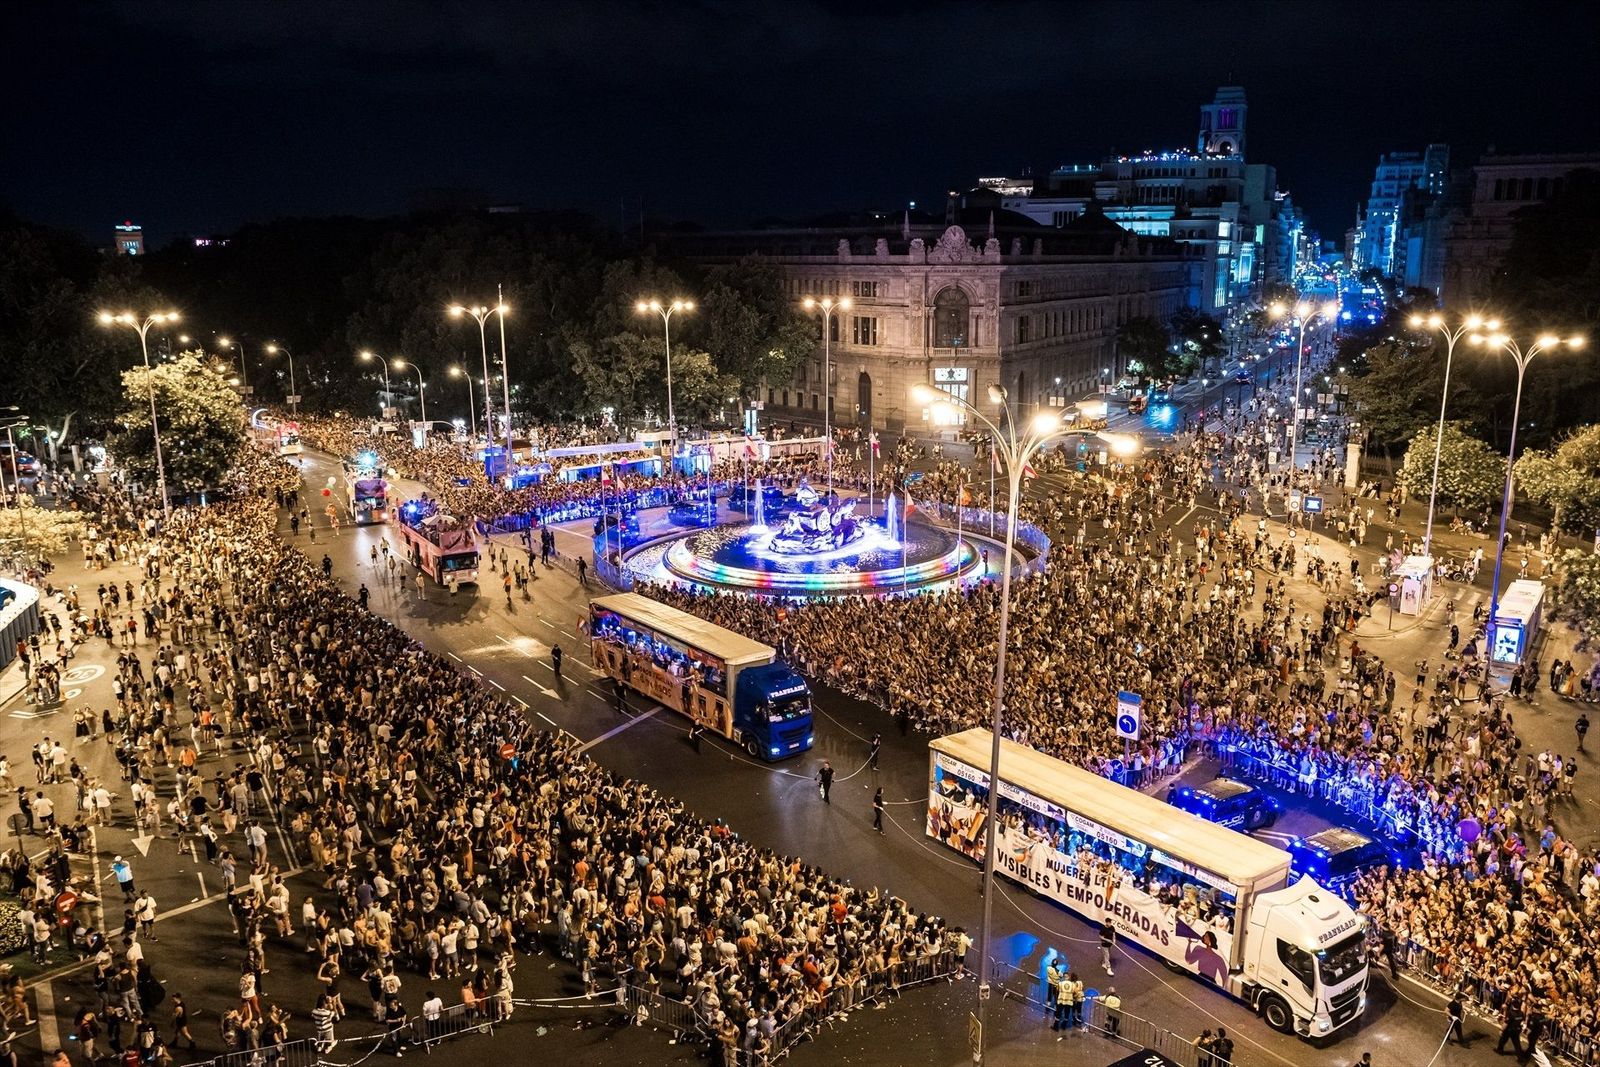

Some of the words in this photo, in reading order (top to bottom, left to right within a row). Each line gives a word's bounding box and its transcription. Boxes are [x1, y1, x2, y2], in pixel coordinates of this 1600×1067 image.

[957, 769, 976, 782] 05160
[1021, 798, 1041, 811] 05160
[1074, 816, 1095, 829] COGAM
[1096, 831, 1118, 846] 05160
[996, 847, 1051, 890] VISIBLES
[1055, 880, 1064, 894] Y
[1066, 884, 1170, 947] EMPODERADAS
[1116, 922, 1139, 937] COGAM
